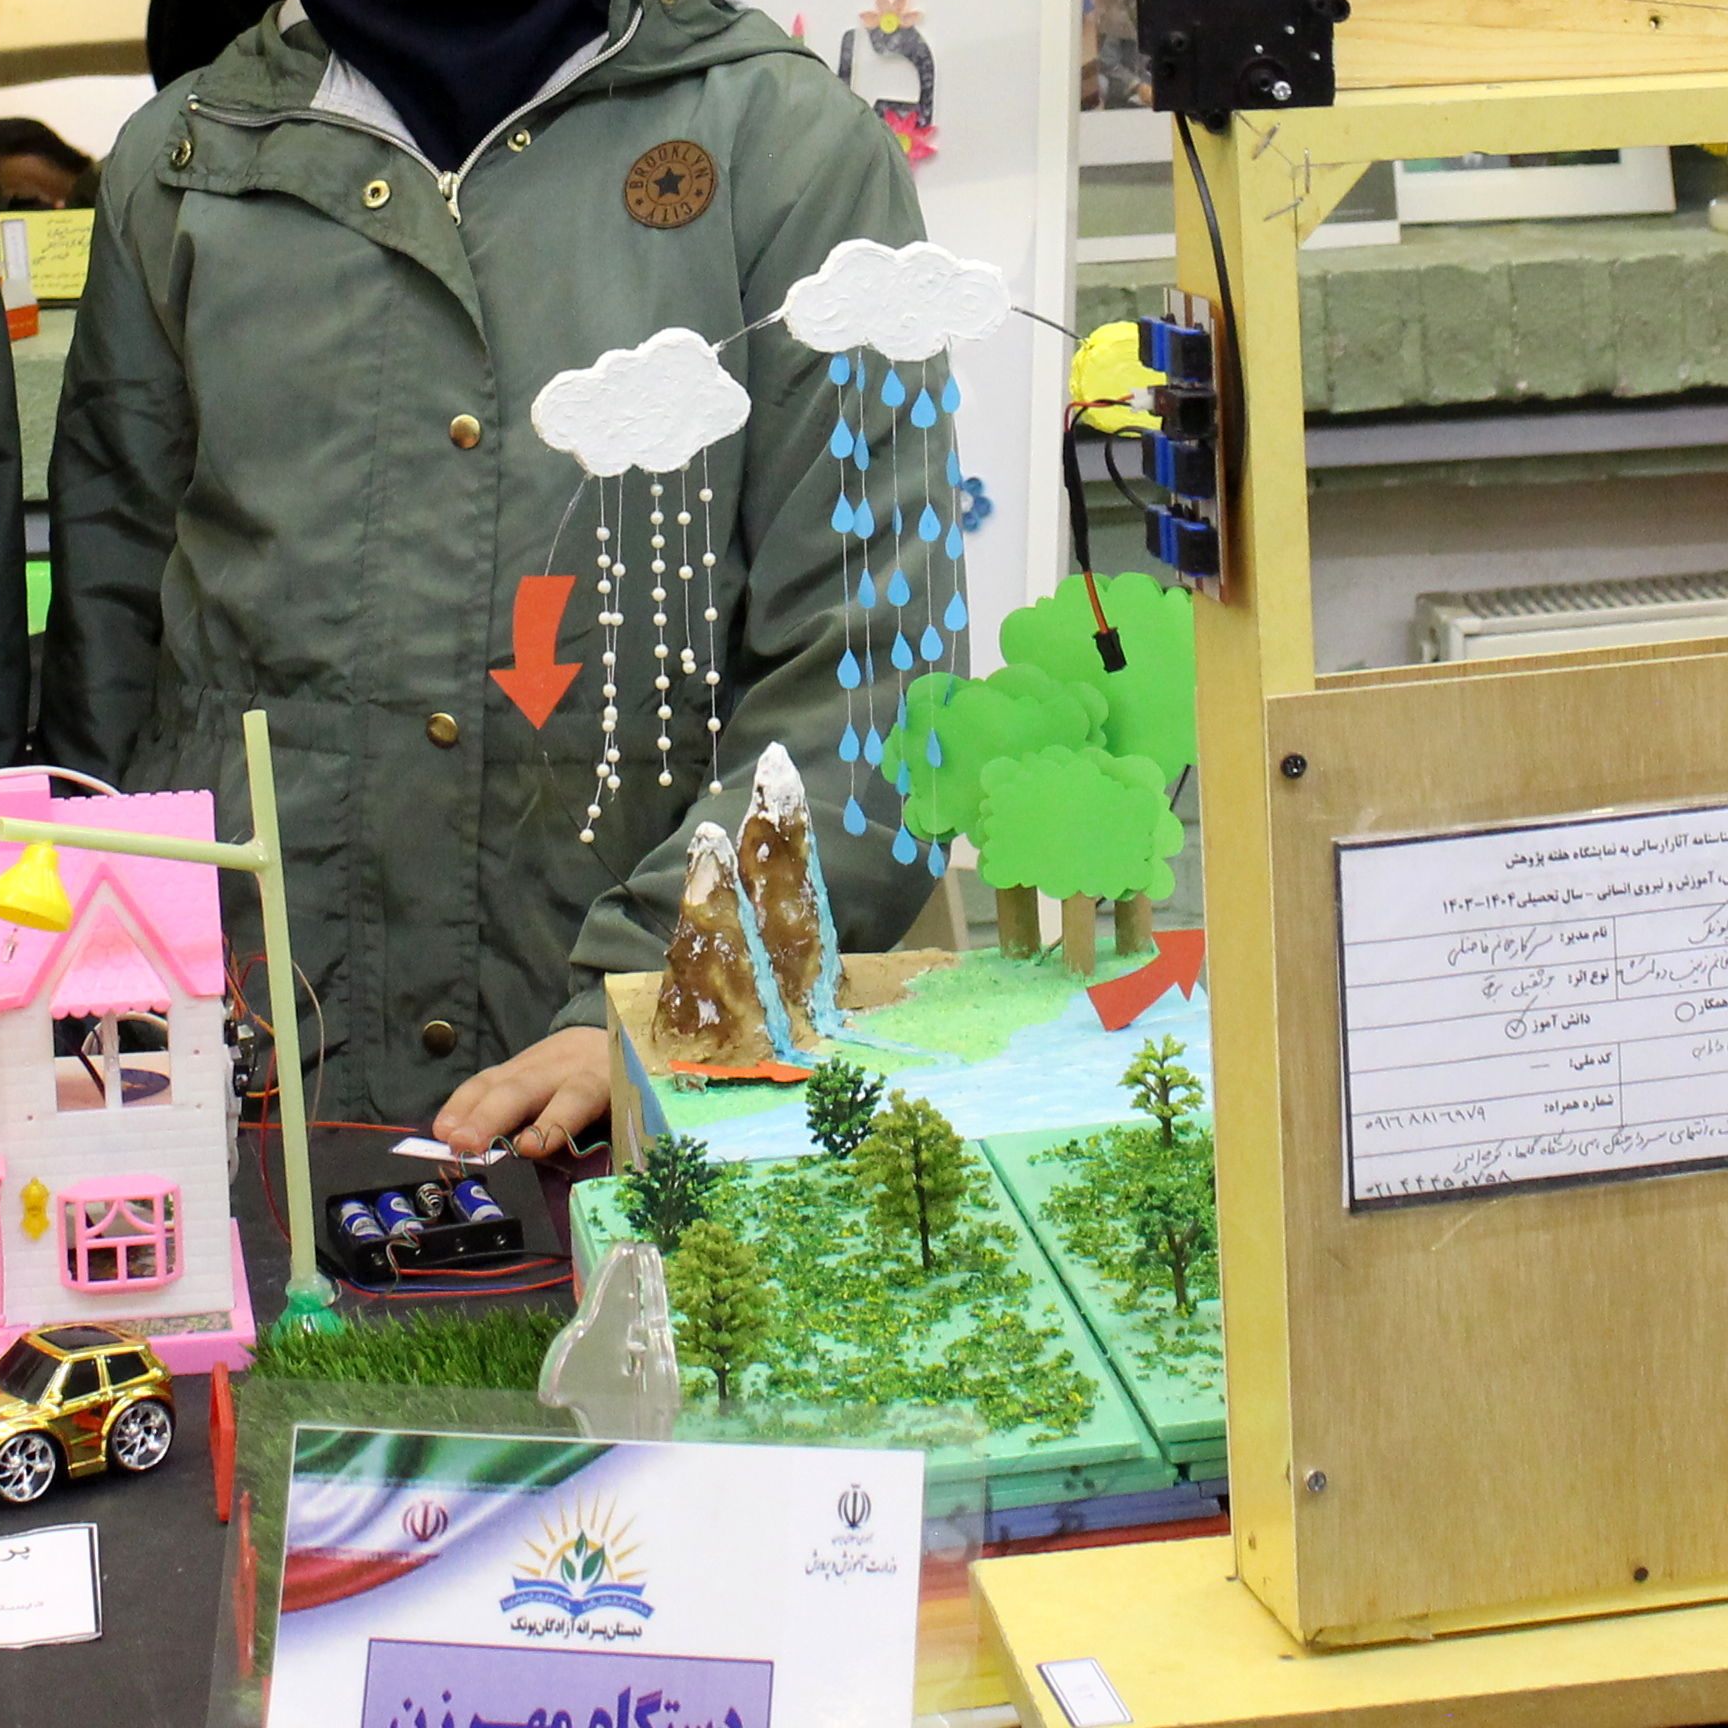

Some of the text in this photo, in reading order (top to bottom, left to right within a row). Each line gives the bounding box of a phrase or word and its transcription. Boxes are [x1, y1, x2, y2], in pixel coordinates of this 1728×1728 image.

[1548, 850, 1569, 862] هفته
[1573, 845, 1616, 859] نمایشگاه
[1620, 846, 1629, 856] به
[1506, 853, 1544, 869] پژوهش
[1634, 881, 1663, 896] نیروی
[1668, 882, 1677, 892] و
[1676, 871, 1714, 891] آموزش
[1517, 890, 1559, 908] تحصیلی
[1562, 889, 1583, 903] سال
[1597, 883, 1630, 900] انسانی
[1560, 927, 1607, 945] نام مدیر:
[1568, 970, 1609, 987] نوع اثر:
[1699, 998, 1728, 1014] همکار
[1533, 1013, 1590, 1033] دانش آموز
[1570, 1052, 1611, 1071] کد ملی:
[1545, 1095, 1613, 1115] شماره همراه:
[607, 1621, 643, 1642] دبستان
